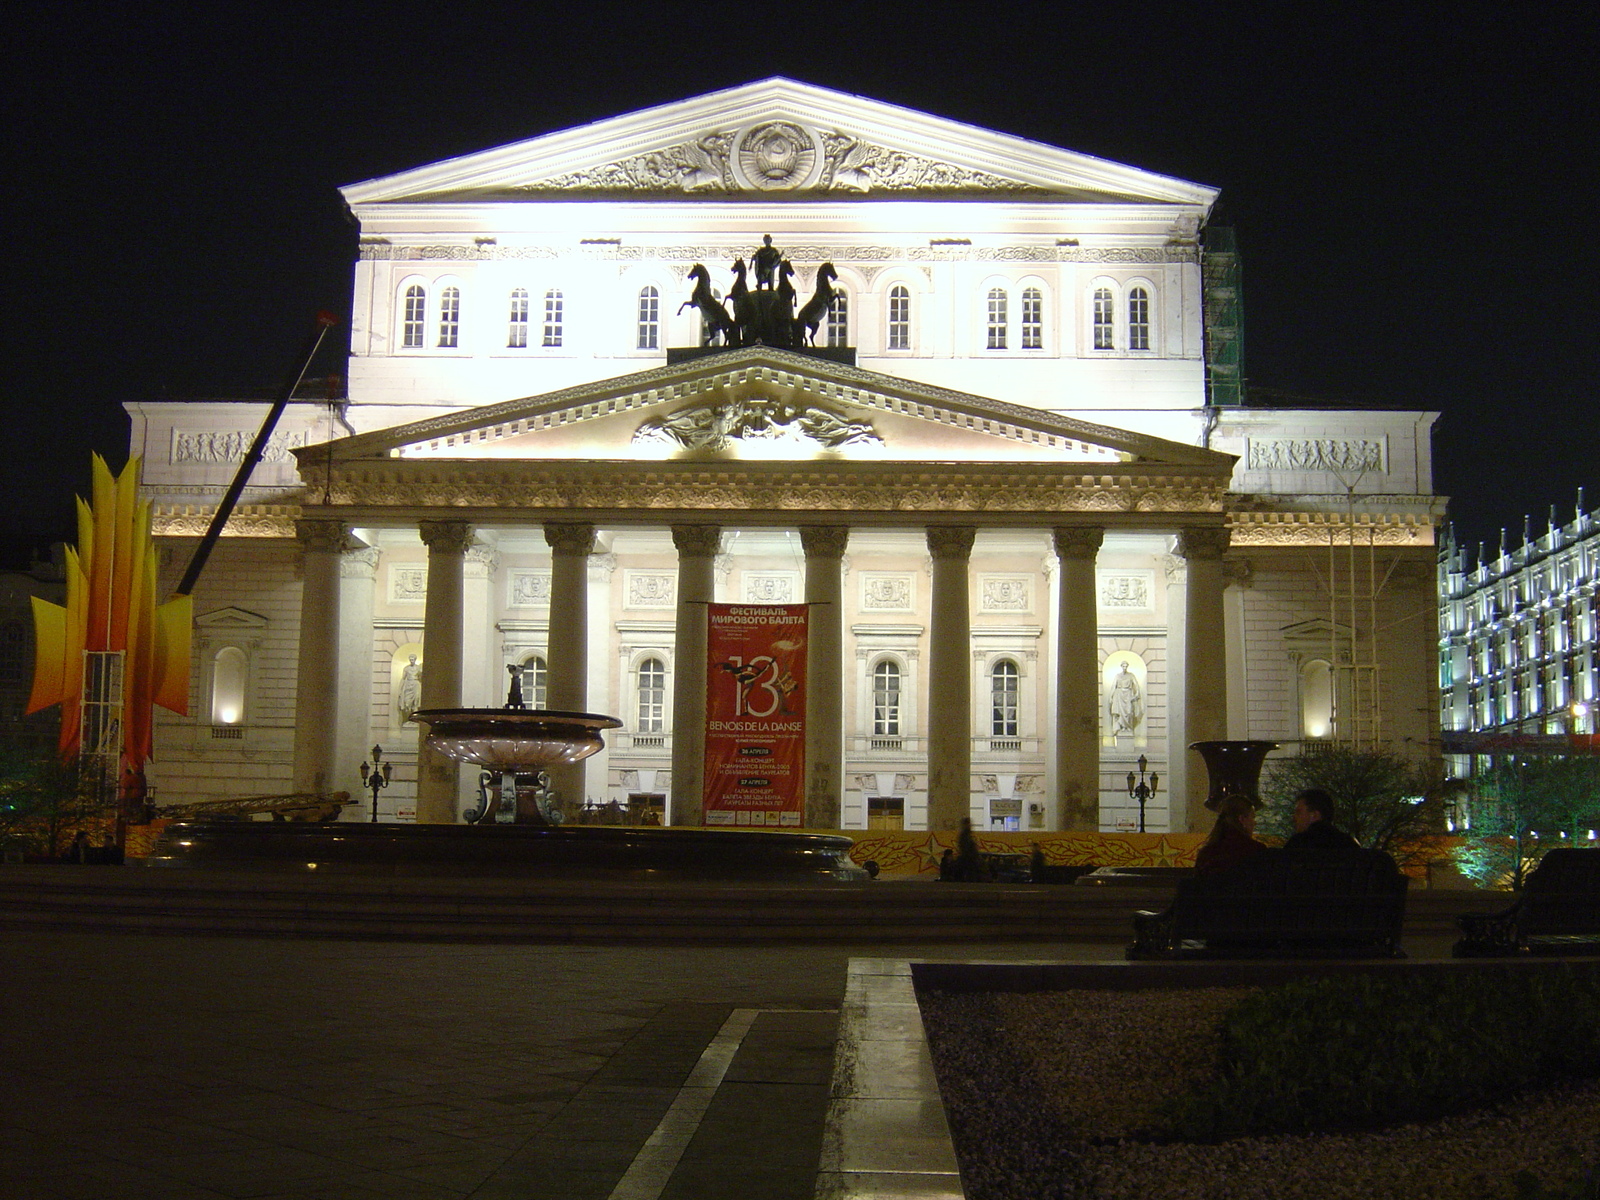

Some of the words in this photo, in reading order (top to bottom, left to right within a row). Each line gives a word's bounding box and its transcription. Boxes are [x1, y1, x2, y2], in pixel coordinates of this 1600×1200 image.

[729, 607, 788, 616] ФЕСТИВАЛЬ
[711, 615, 768, 624] МИРОВОГО
[768, 616, 805, 625] БАЛЕТА
[728, 655, 779, 717] 13
[709, 721, 744, 731] BENOIS
[745, 722, 758, 731] DE
[759, 722, 770, 731] LA
[771, 722, 803, 732] DANSE
